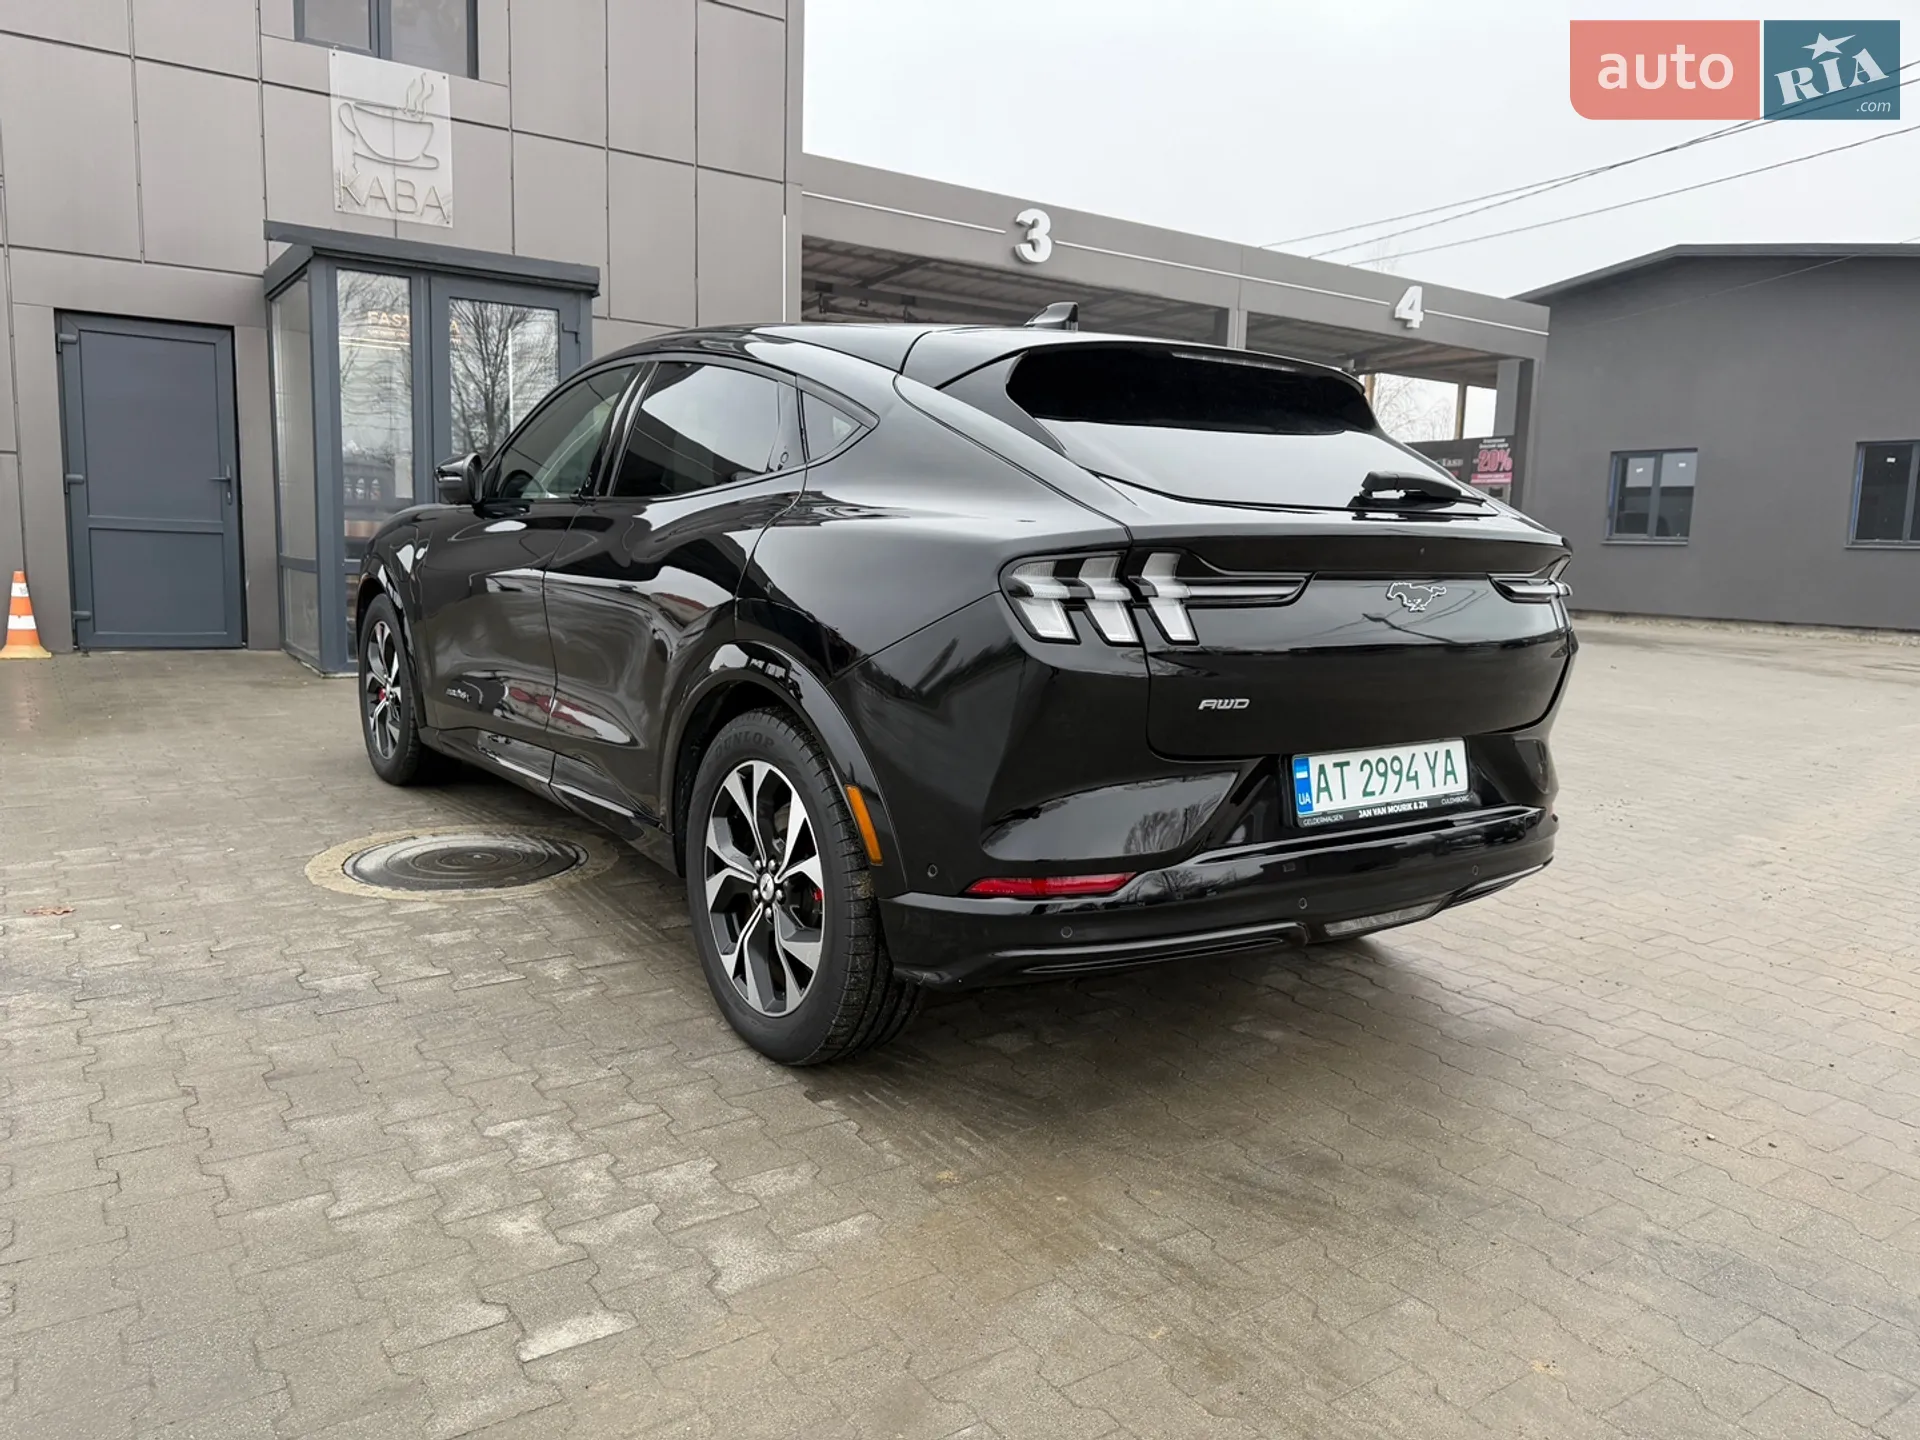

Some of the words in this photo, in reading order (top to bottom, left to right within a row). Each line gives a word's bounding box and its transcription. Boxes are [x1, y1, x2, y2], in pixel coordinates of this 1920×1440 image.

[1015, 208, 1052, 264] 3
[1394, 285, 1424, 329] 4
[1198, 698, 1250, 710] AWD
[715, 730, 775, 755] DUNLOP
[1316, 760, 1351, 804] AT
[1359, 753, 1420, 798] 2994
[1424, 749, 1459, 789] YA
[1299, 793, 1312, 806] UA
[1358, 808, 1372, 819] JAN
[1372, 807, 1387, 817] VAN
[1387, 803, 1413, 815] MOURIK
[1419, 800, 1429, 810] ZN
